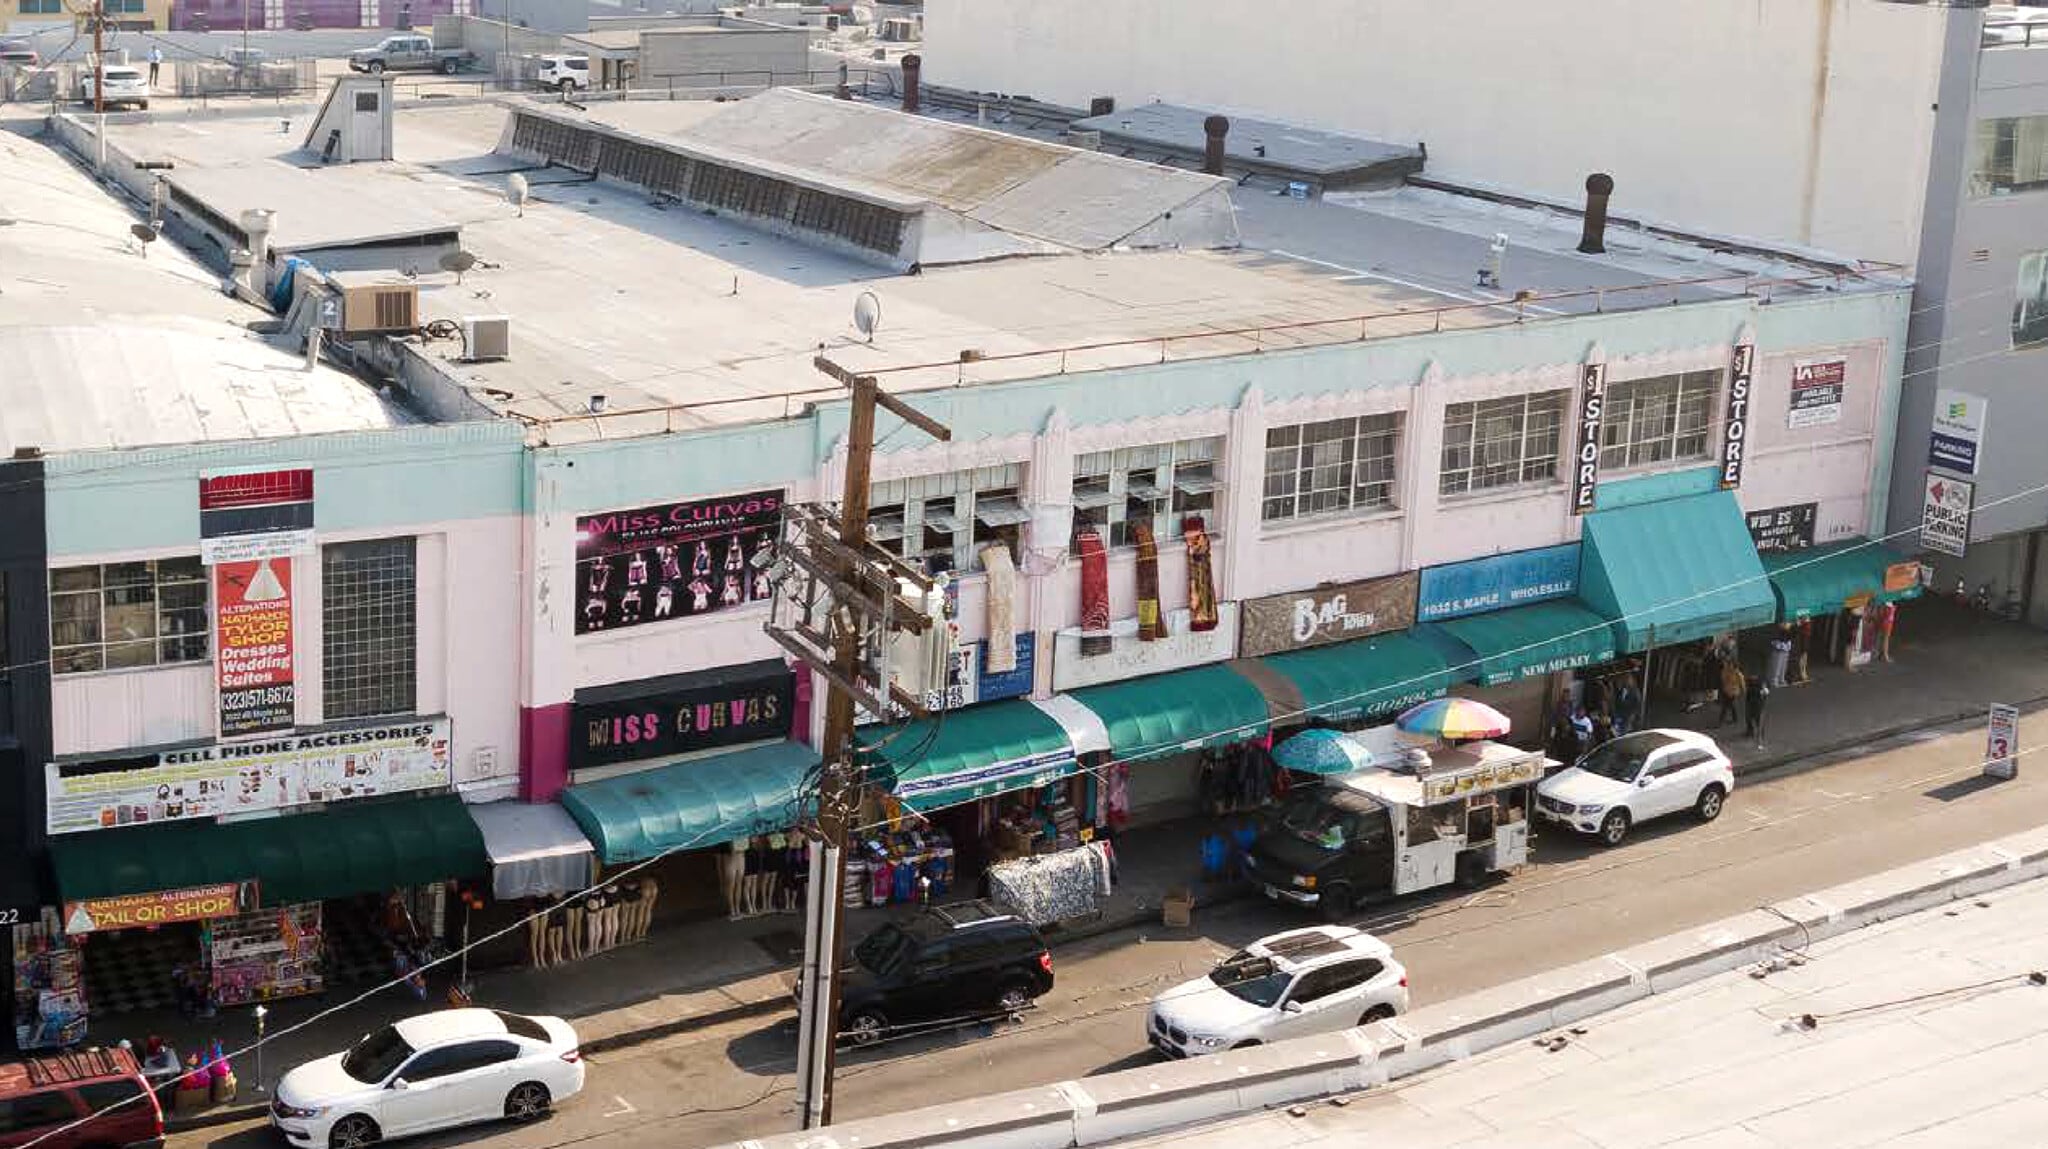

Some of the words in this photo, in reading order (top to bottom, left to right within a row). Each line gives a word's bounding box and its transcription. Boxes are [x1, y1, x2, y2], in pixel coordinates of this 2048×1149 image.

[1725, 380, 1746, 481] STORE
[1579, 399, 1600, 506] STORE
[588, 512, 661, 534] Miss
[670, 497, 777, 523] Curvas
[1925, 504, 1966, 525] PUBLIC
[220, 600, 290, 615] ALTERATIONS
[1463, 592, 1499, 610] MAPLE
[1511, 580, 1571, 600] WHOLESALE
[223, 621, 289, 638] TYLOR
[1293, 593, 1348, 642] BAG
[228, 630, 286, 647] SHOP
[221, 644, 287, 660] Dresses
[221, 655, 290, 675] Wedding
[1521, 662, 1547, 677] NEW
[1548, 654, 1591, 673] MICKEY
[589, 713, 659, 747] MISS
[676, 694, 778, 734] CURVAS
[165, 750, 215, 764] CELL
[221, 740, 294, 759] PHONE
[299, 724, 433, 749] ACCESSORIES
[160, 884, 232, 902] ALTERATIONS
[91, 905, 167, 927] TAILOR
[173, 896, 232, 917] SHOP
